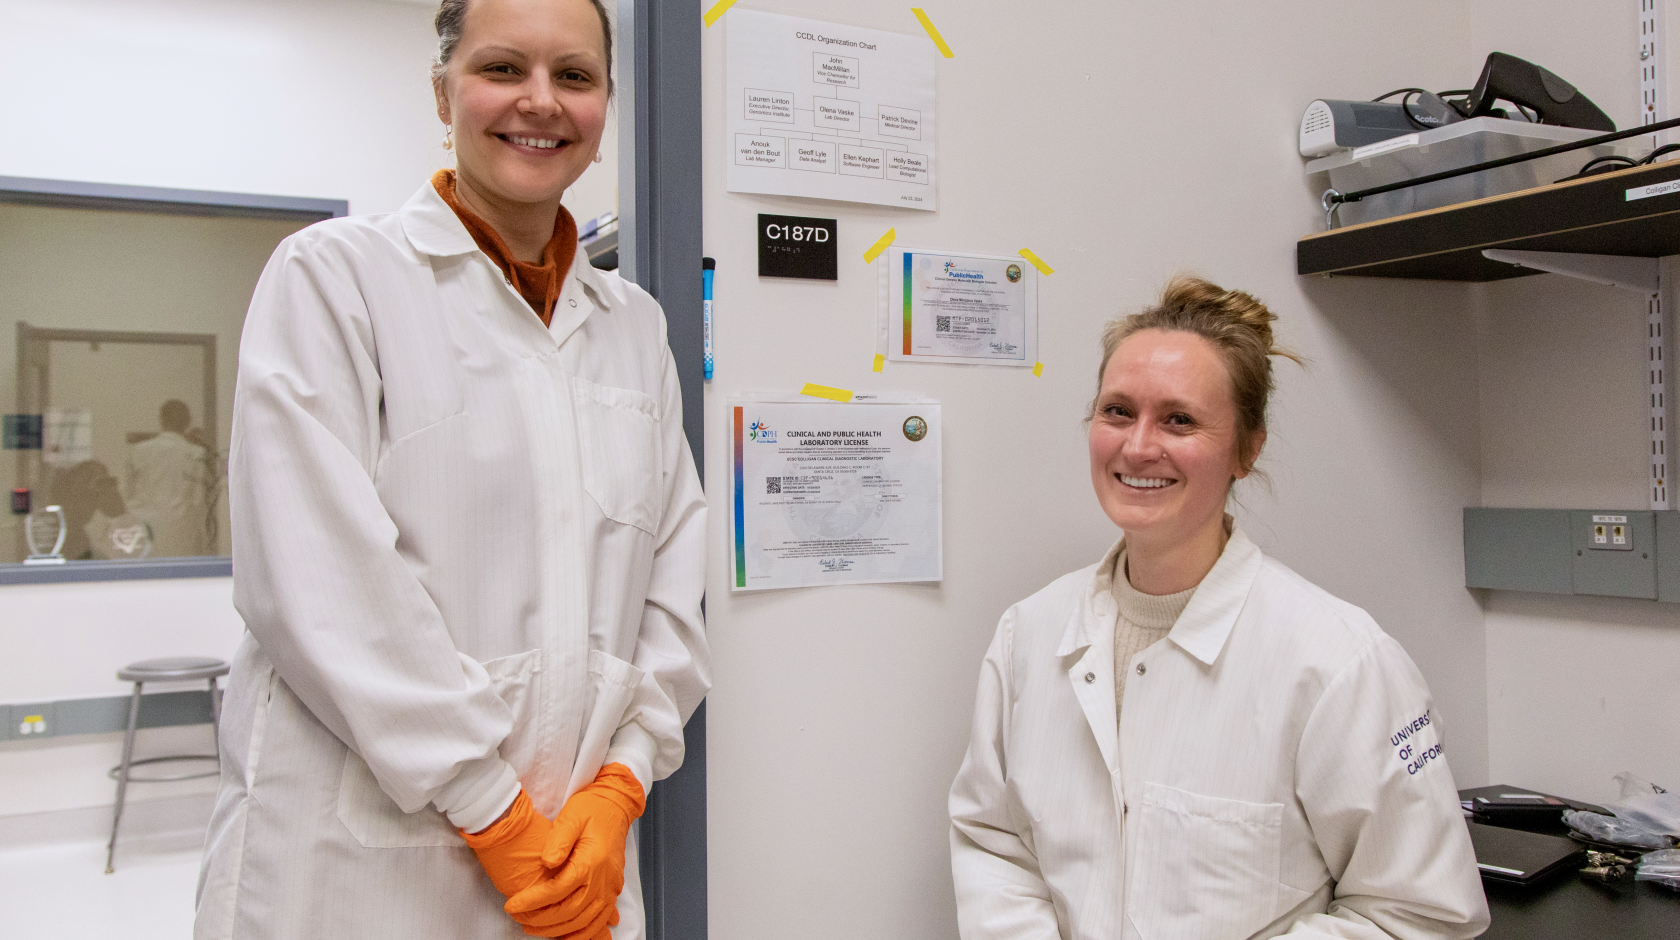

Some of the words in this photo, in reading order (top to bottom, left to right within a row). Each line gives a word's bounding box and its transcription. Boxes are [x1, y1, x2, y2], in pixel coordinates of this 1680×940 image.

[796, 32, 816, 41] CCDL
[818, 34, 858, 48] Organization
[859, 42, 876, 50] Chart
[822, 64, 850, 73] MacMillan
[749, 95, 770, 103] Lauren
[820, 106, 836, 114] Olena
[882, 114, 899, 122] Patrick
[901, 117, 918, 125] Devine
[858, 155, 880, 164] Kephart
[894, 157, 906, 165] Holly
[1646, 186, 1670, 194] Colligan
[766, 224, 829, 242] C187D
[1399, 744, 1412, 760] OF
